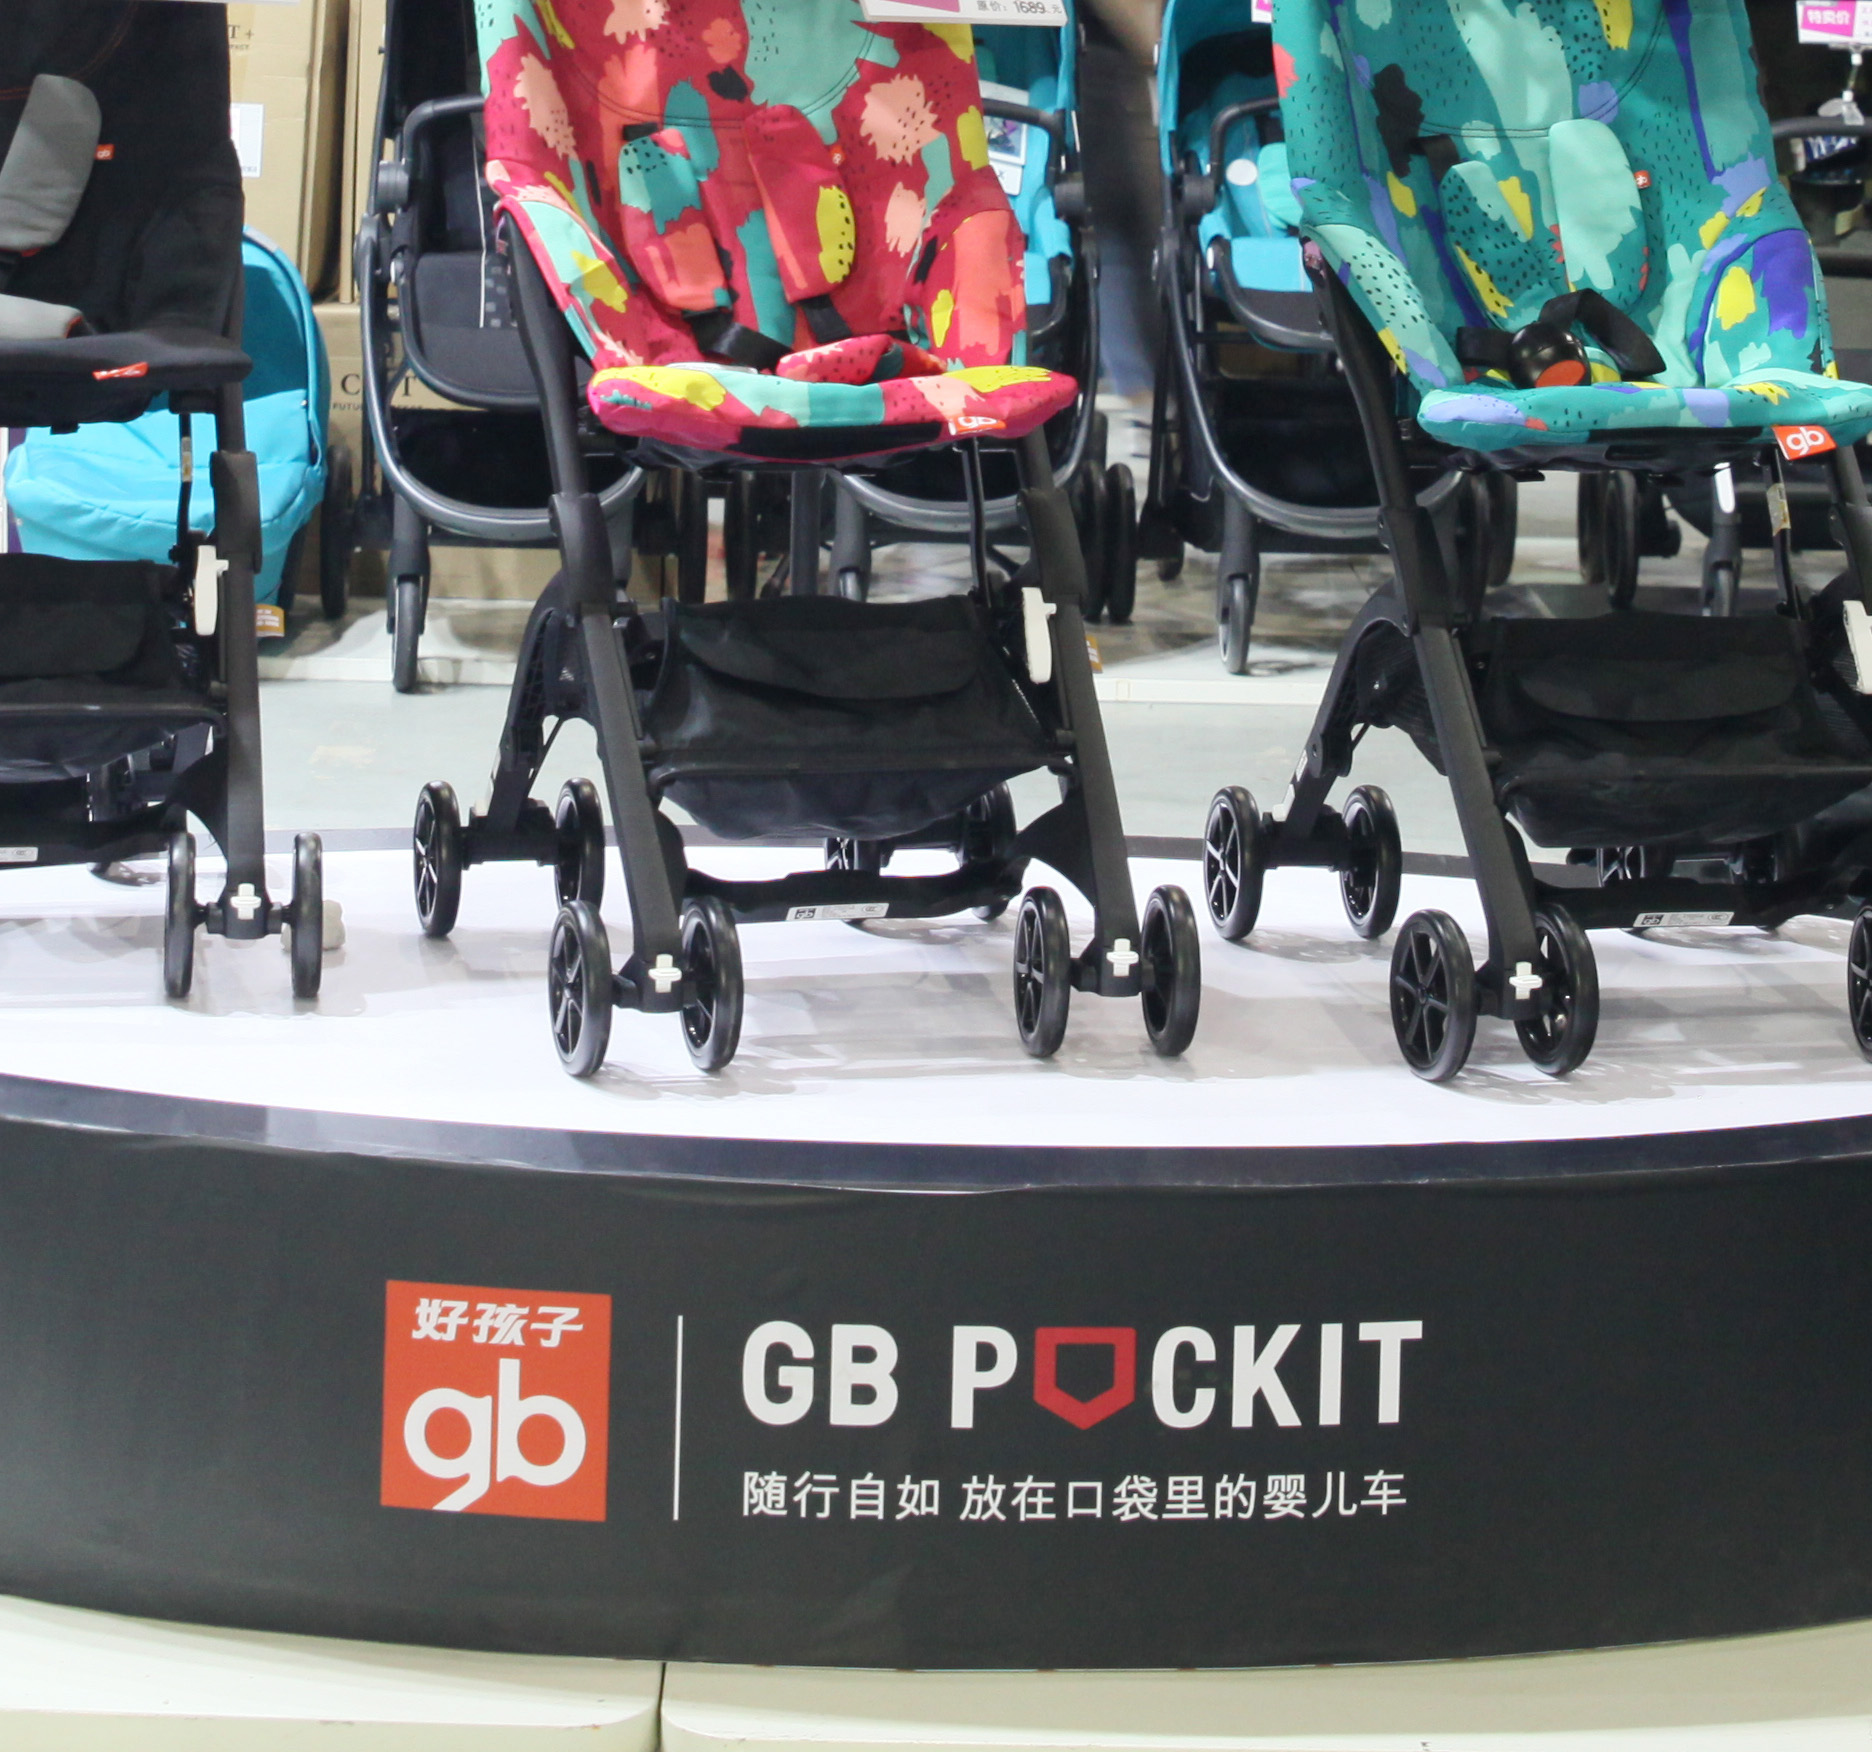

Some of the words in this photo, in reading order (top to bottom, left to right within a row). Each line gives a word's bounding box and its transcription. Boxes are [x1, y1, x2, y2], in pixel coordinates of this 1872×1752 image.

[1013, 1, 1046, 14] 1689
[1786, 425, 1826, 456] gb
[411, 1297, 584, 1348] 好孩子
[742, 1319, 900, 1428] GB
[403, 1356, 587, 1512] gb
[741, 1471, 940, 1521] 随行自如
[959, 1470, 1408, 1522] 放在口袋里的婴儿车
